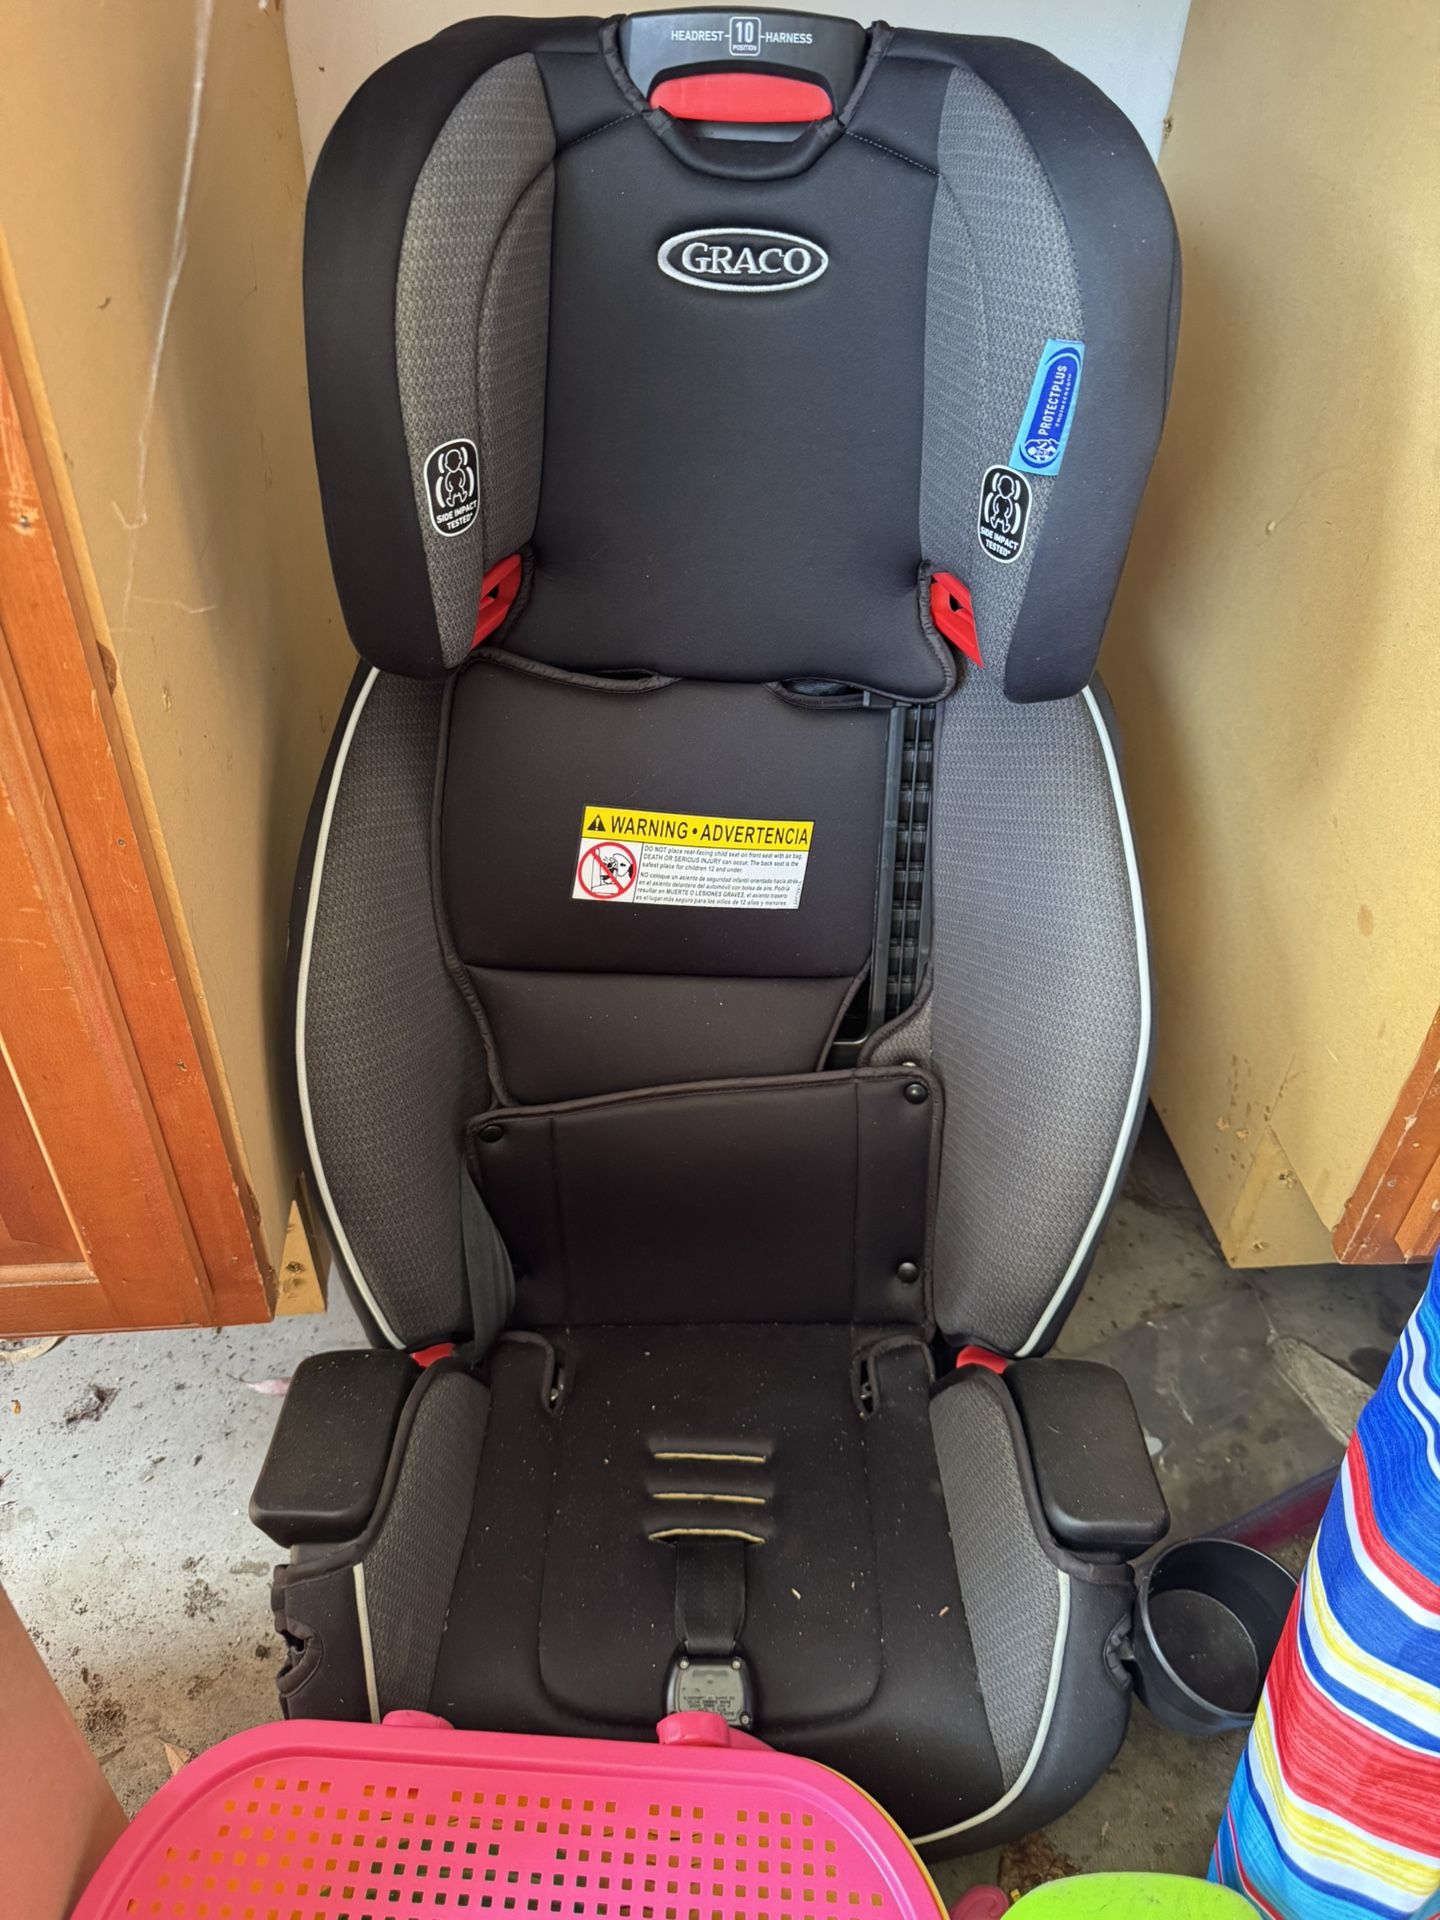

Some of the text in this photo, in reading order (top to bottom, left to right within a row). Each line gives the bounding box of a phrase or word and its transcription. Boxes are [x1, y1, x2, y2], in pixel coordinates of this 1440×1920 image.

[671, 21, 813, 44] HEADREST 10 HARNESS
[682, 242, 811, 275] GRACO
[1038, 365, 1068, 436] PROTECTPLUS
[436, 500, 477, 524] SIDE IMPACT
[980, 526, 1019, 550] SIDE IMPACT
[611, 815, 808, 845] WARNING ADVERTENCIA
